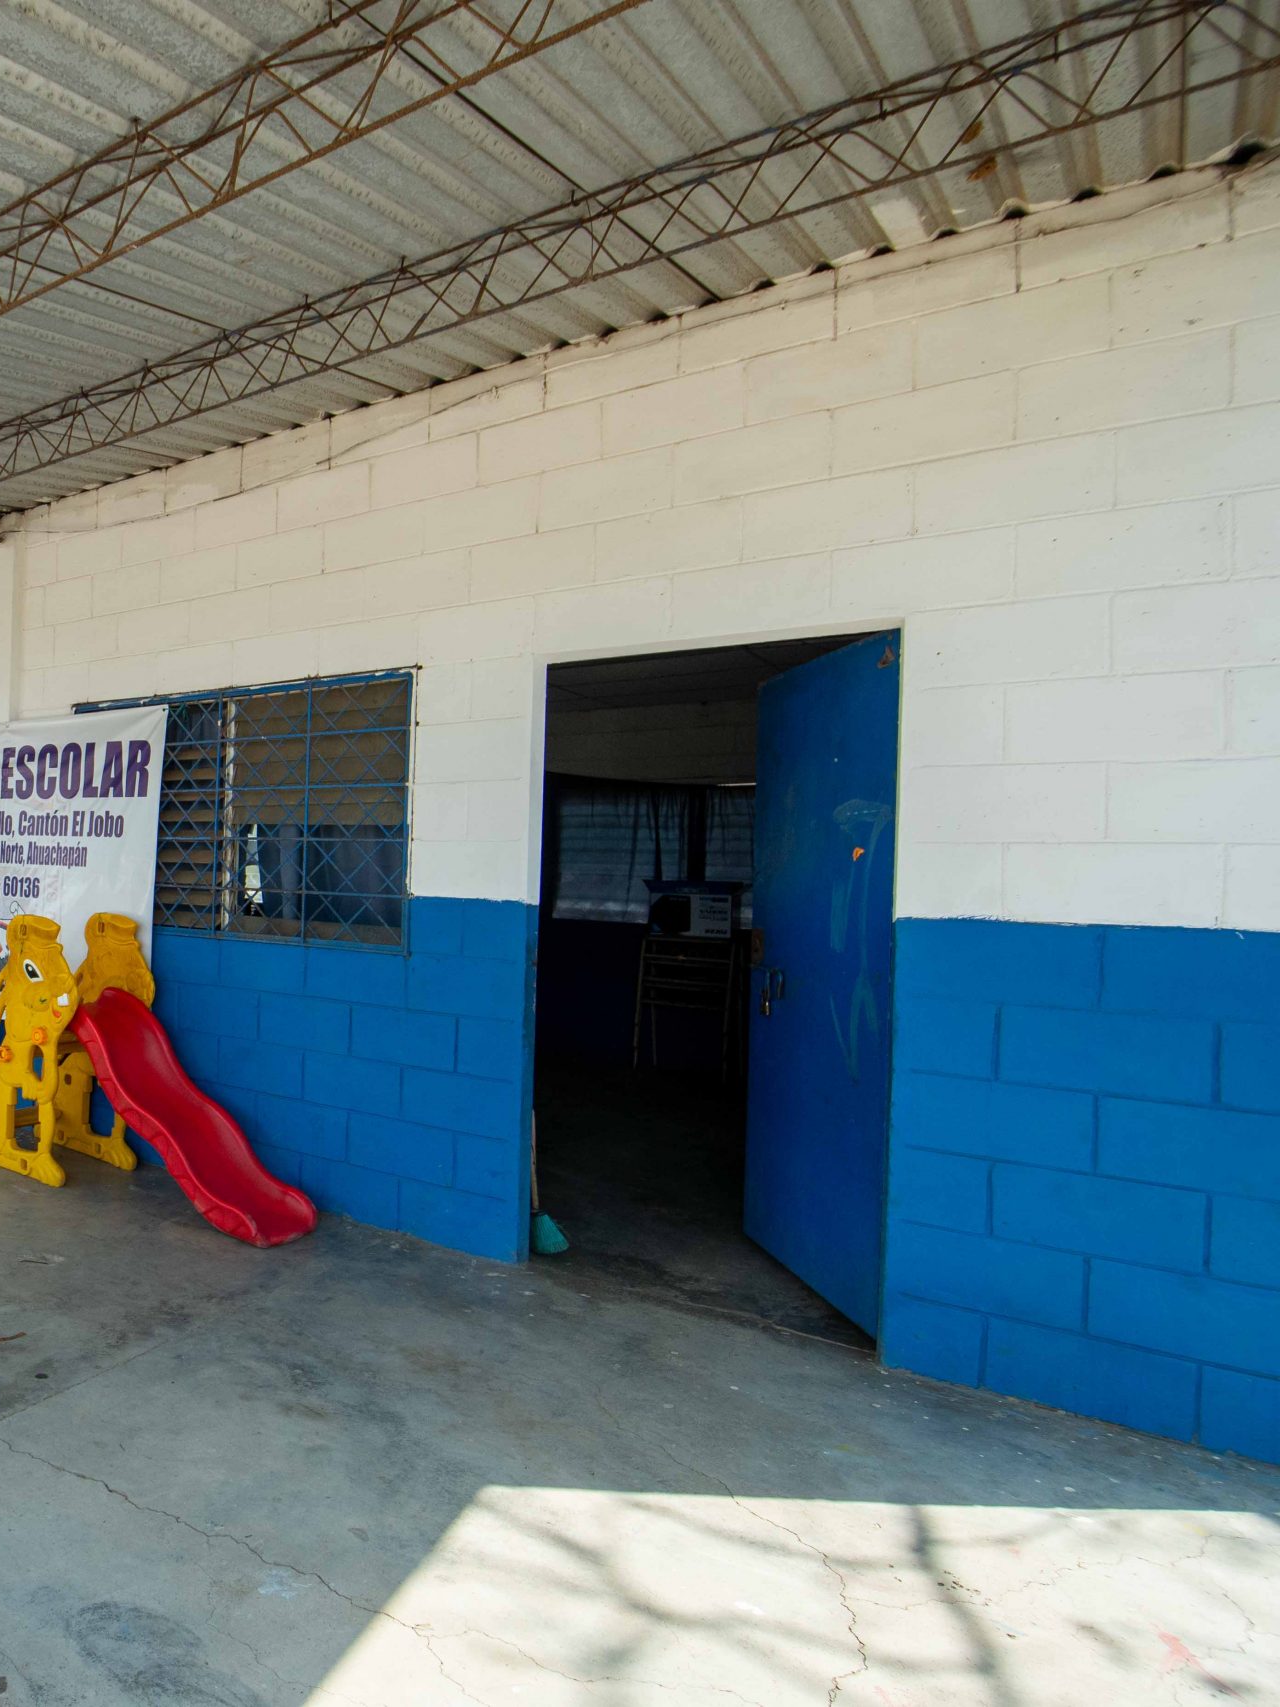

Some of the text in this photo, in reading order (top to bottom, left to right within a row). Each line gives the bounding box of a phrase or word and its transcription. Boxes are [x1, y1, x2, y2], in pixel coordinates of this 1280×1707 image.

[0, 740, 151, 800] ESCOLAR
[18, 809, 69, 837] Cantón
[71, 811, 85, 837] El
[86, 810, 125, 838] Jobo
[0, 841, 26, 866] Norte,
[27, 841, 88, 868] Ahuachapán
[2, 875, 41, 899] 60136
